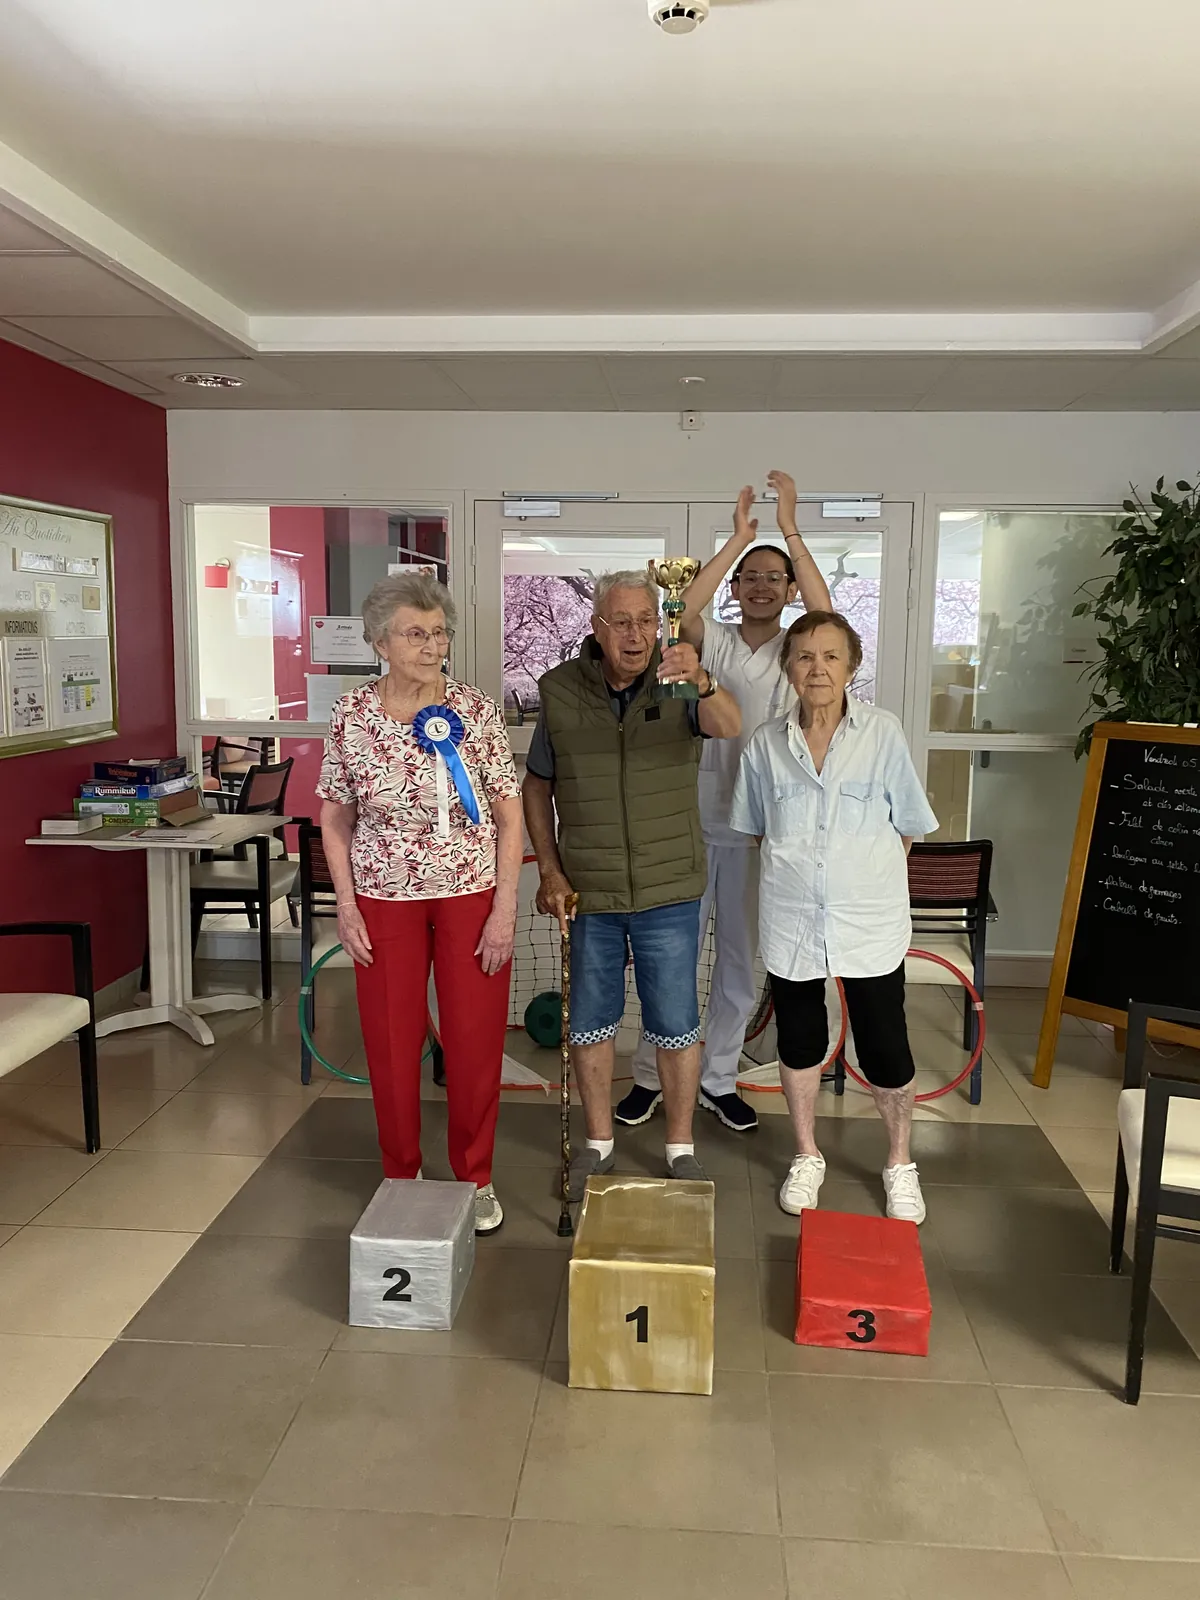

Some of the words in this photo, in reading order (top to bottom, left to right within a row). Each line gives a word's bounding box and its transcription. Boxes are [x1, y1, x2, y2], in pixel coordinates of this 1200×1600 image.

[24, 516, 72, 544] Quotidien
[4, 620, 38, 634] INFORMATIONS
[1144, 745, 1177, 766] Vendredi
[95, 786, 136, 796] Rummikub
[1123, 773, 1169, 794] Salade
[1152, 818, 1164, 831] de
[382, 1267, 412, 1302] 2
[625, 1305, 649, 1343] 1
[845, 1309, 877, 1343] 3
